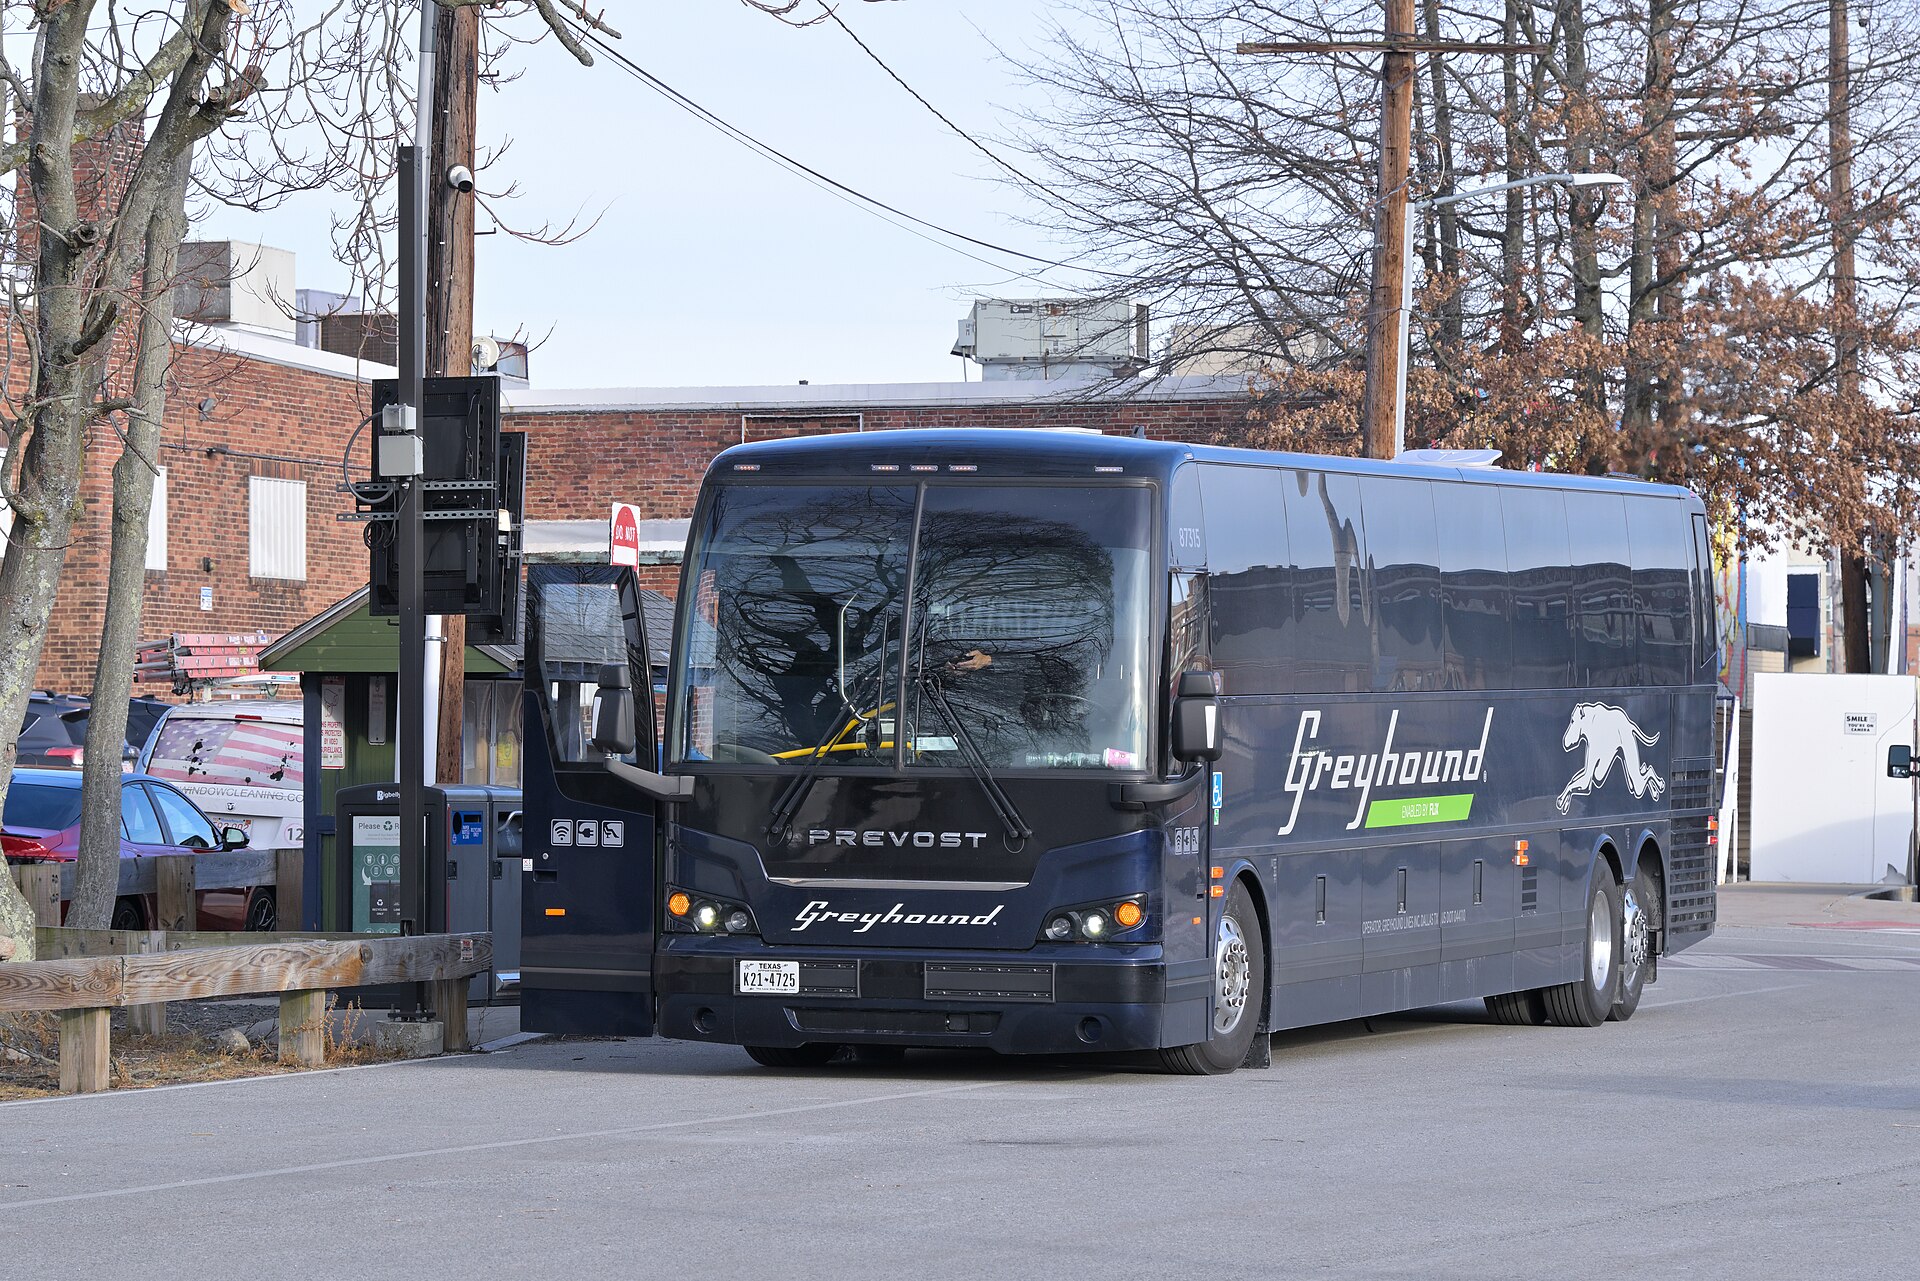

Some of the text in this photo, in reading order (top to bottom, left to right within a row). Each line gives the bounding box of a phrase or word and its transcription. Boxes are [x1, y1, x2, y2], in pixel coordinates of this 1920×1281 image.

[616, 524, 636, 542] DO NOT
[1179, 527, 1201, 548] 87315
[1277, 707, 1494, 836] Greyhound
[1402, 804, 1421, 818] ENABLED
[1422, 803, 1429, 817] BY
[358, 822, 381, 830] Please
[808, 829, 987, 848] PREVOST
[790, 900, 1005, 933] Greyhound
